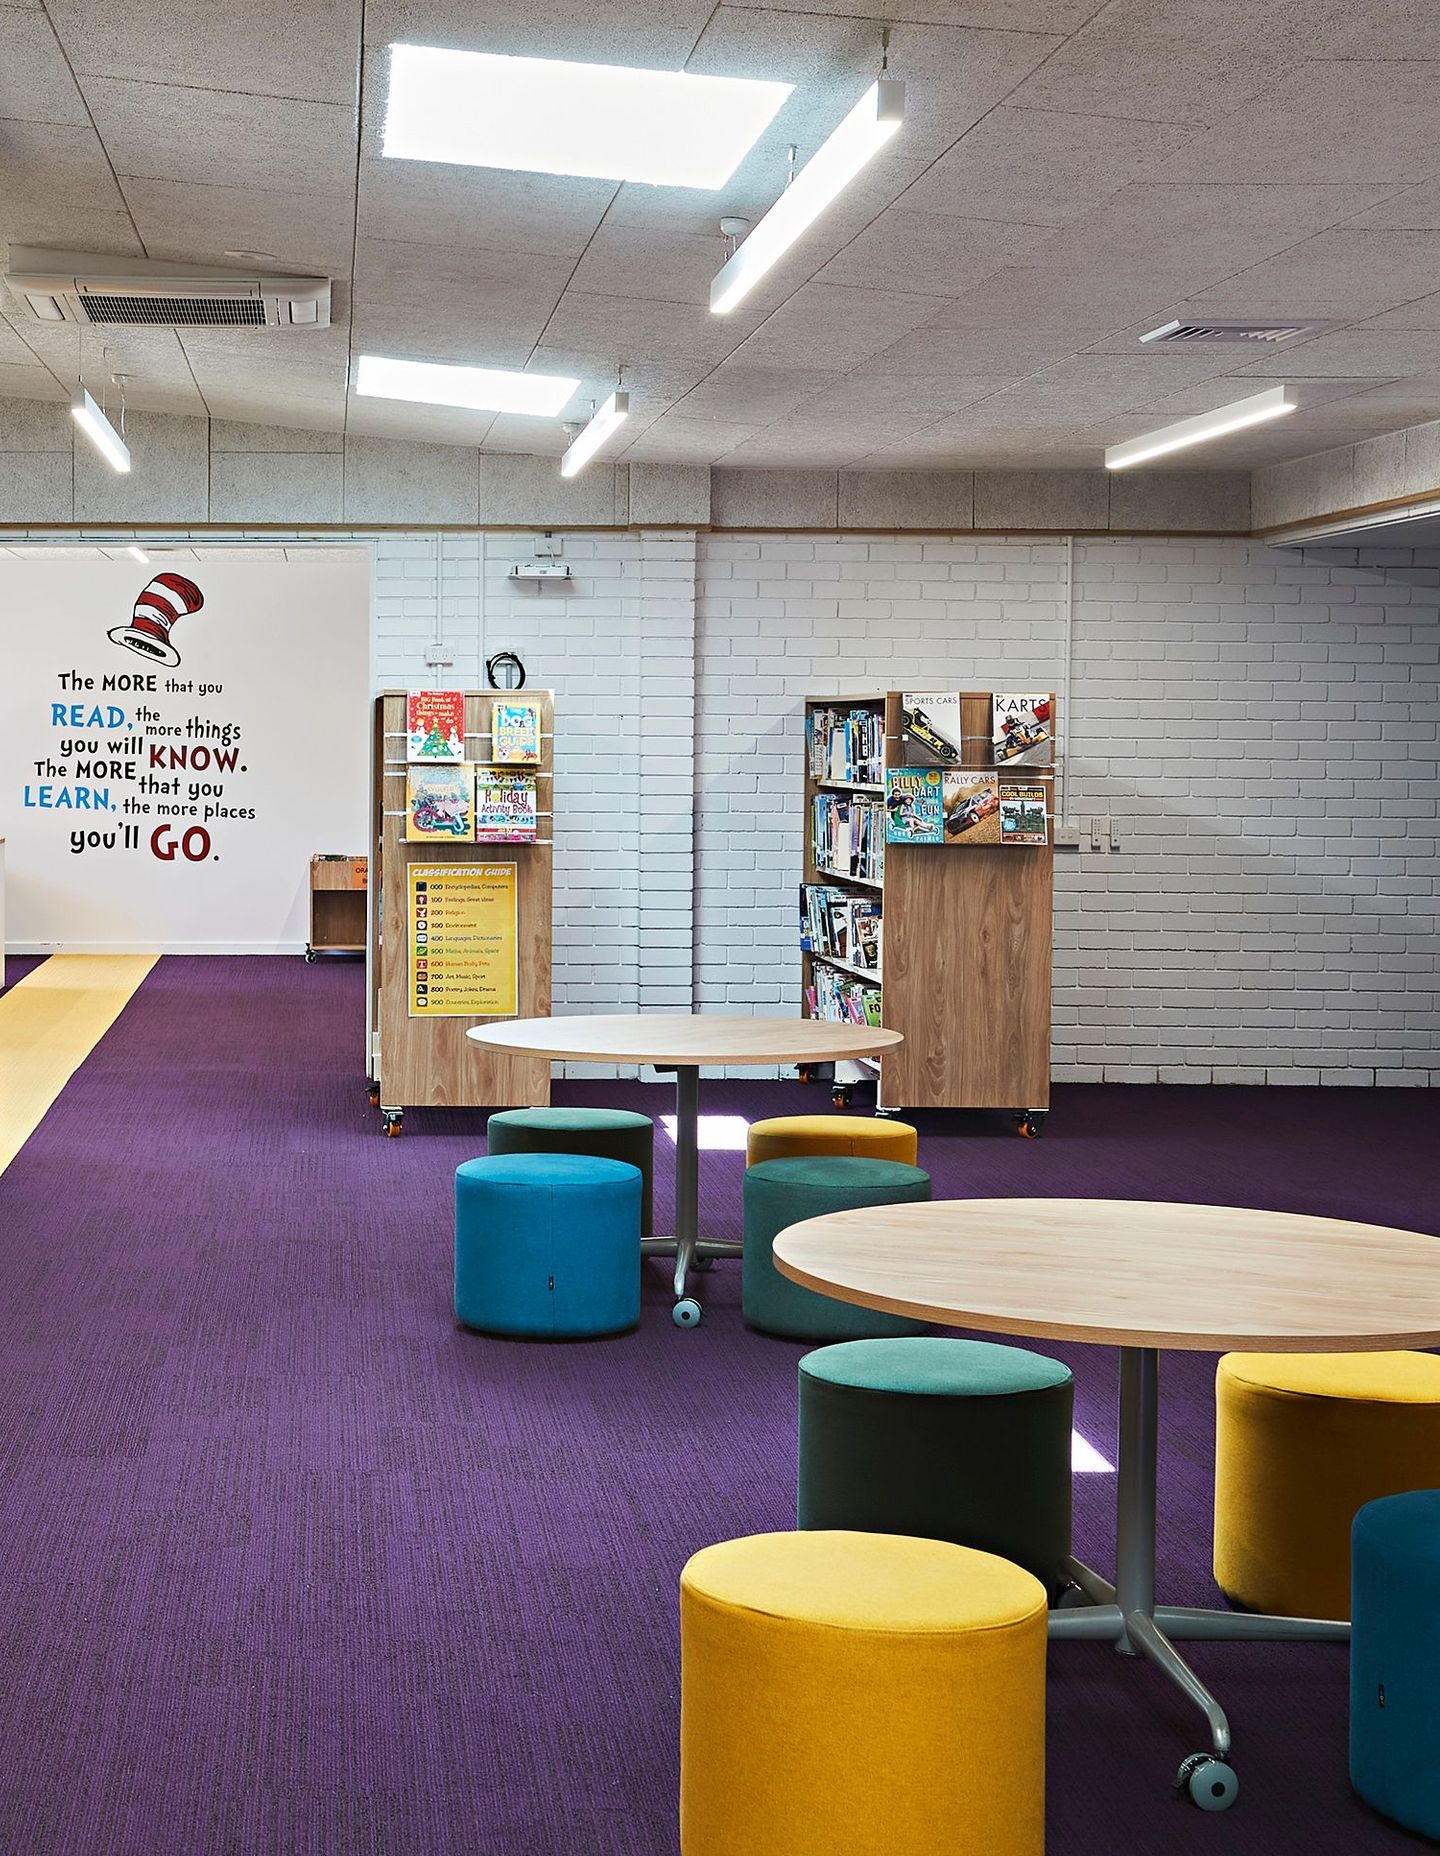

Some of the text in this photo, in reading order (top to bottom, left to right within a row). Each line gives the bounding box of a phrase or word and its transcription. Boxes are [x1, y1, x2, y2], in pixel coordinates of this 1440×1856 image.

[58, 670, 222, 696] The MORE that you
[416, 702, 455, 711] Christmas
[905, 697, 958, 705] SPORTS CARS
[996, 699, 1048, 712] KARTS
[51, 704, 160, 730] READ, the
[146, 717, 241, 746] more things
[60, 737, 143, 756] you will
[34, 759, 136, 779] The MORE
[149, 744, 247, 773] KNOW.
[139, 774, 223, 800] that you
[892, 776, 922, 789] BILLY
[944, 776, 970, 785] RALLY
[971, 776, 996, 785] CARS
[24, 785, 116, 812] LEARN,
[913, 786, 940, 798] CART
[123, 798, 255, 822] the more places
[70, 822, 219, 861] you'll GO.
